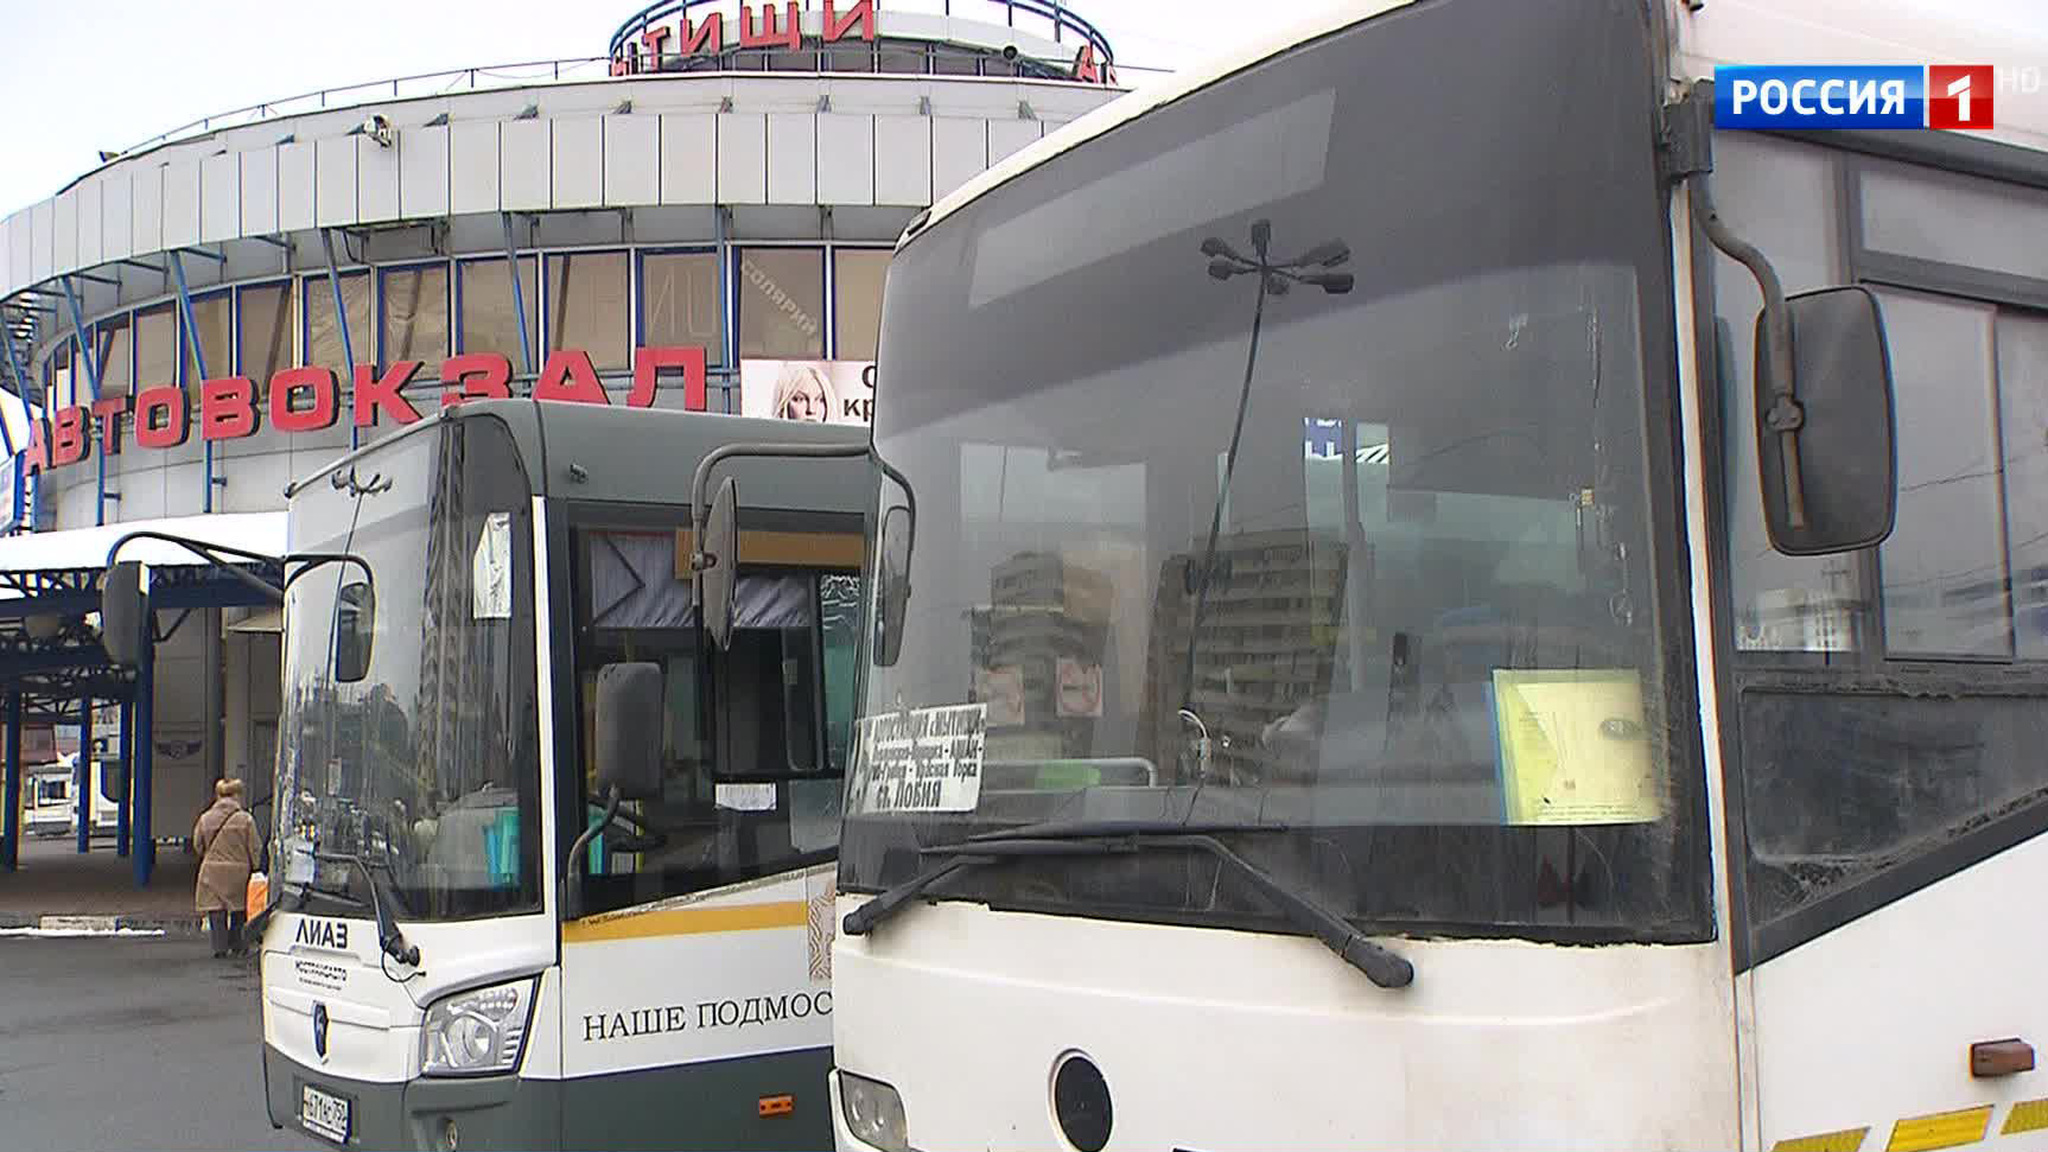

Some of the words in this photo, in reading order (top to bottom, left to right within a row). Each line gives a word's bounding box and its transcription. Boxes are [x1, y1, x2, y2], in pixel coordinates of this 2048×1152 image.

[22, 346, 707, 479] АВТОВОКЗАЛ
[295, 918, 348, 949] ЛИАЗ
[583, 1005, 686, 1042] НАШЕ
[696, 990, 833, 1028] ПОДМОС
